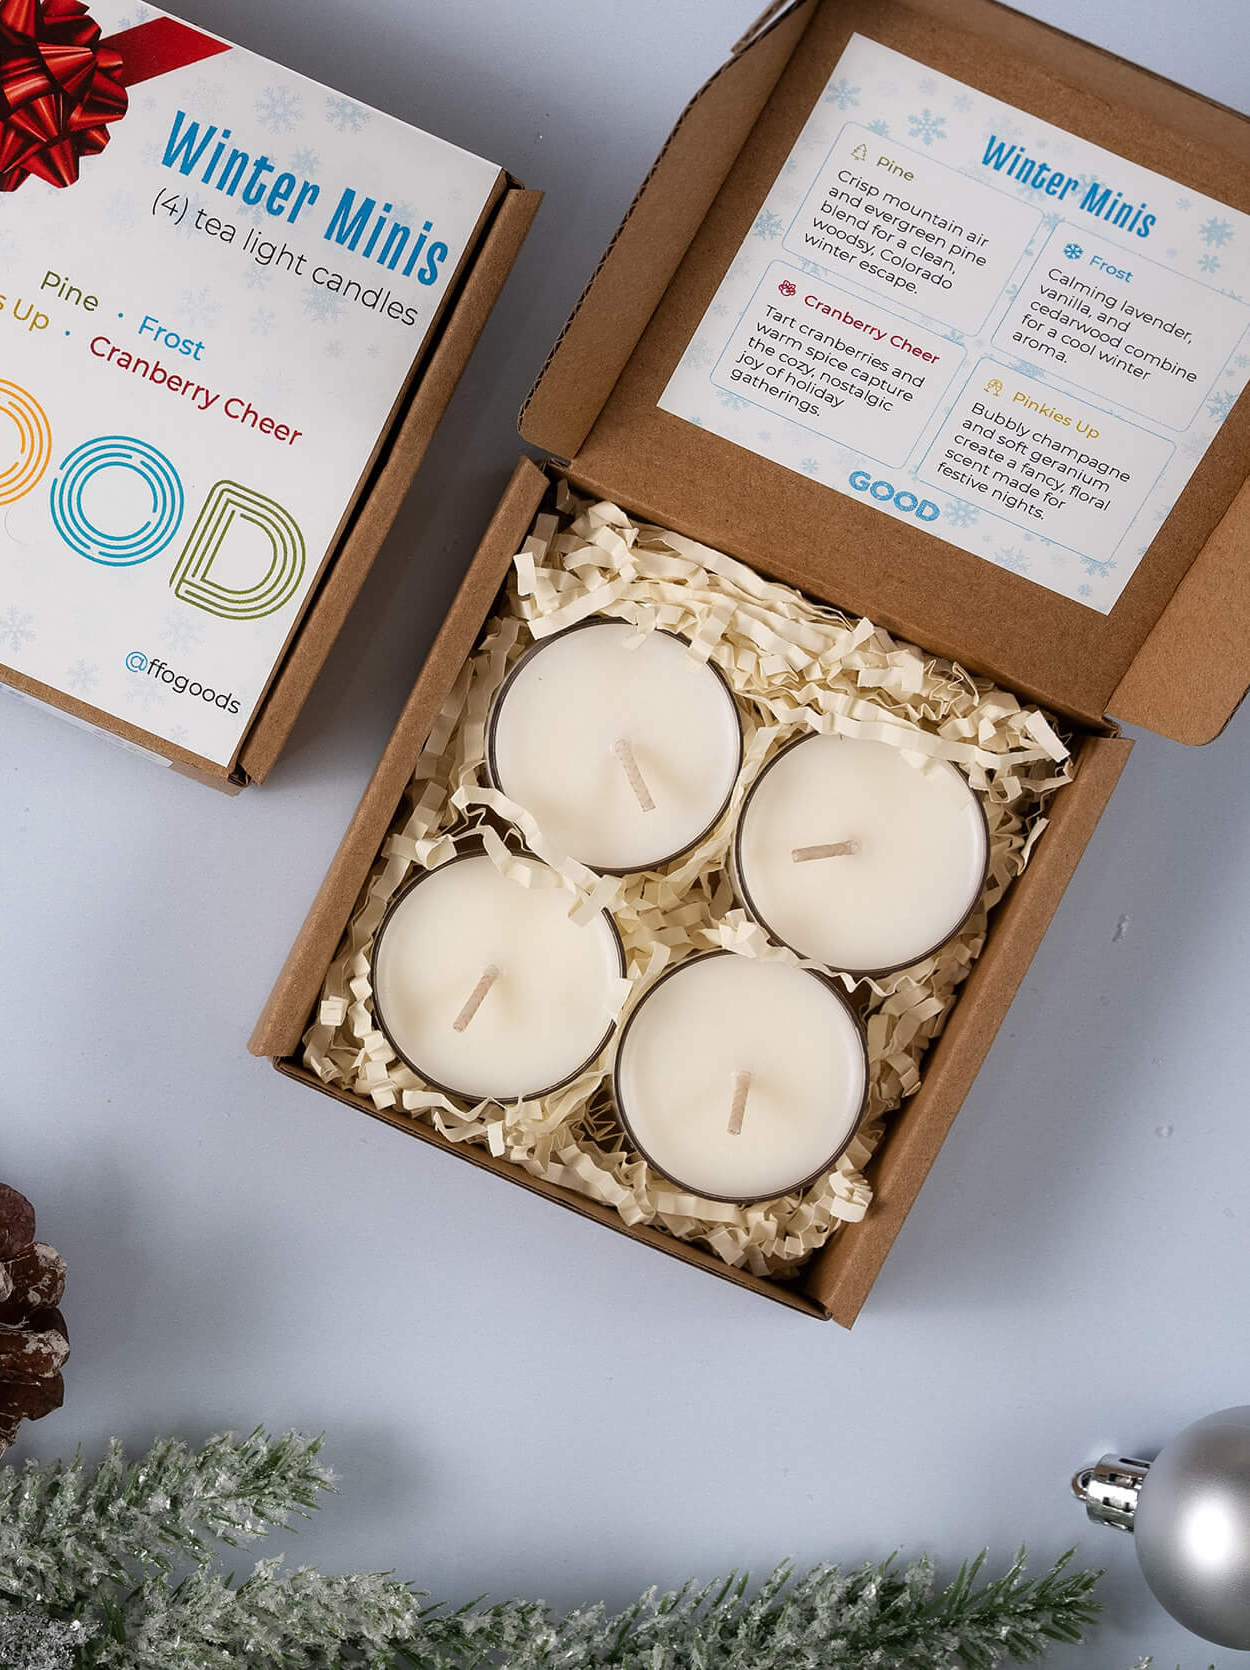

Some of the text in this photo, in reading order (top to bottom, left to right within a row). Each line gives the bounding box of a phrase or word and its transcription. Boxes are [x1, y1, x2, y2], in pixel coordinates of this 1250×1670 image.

[161, 109, 448, 286] Winter Minis
[876, 156, 915, 182] Pine
[981, 135, 1157, 238] Winter Minis
[820, 200, 956, 275] blend for a clean,
[828, 186, 987, 267] and evergreen pine
[838, 170, 990, 248] Crisp mountain air
[152, 187, 419, 326] (4) tea light candles
[805, 233, 918, 294] winter escape.
[813, 217, 953, 290] woodsy, Colorado
[1089, 255, 1134, 284] Frost
[39, 270, 205, 362] Pine Frost
[804, 295, 941, 365] Cranberry Cheer
[1030, 300, 1198, 383] cedarwood combine
[1040, 285, 1132, 333] vanilla, and
[1048, 268, 1193, 345] Calming lavender,
[12, 298, 50, 332] Up
[89, 336, 220, 411] Cranberry
[223, 397, 303, 446] Cheer
[735, 350, 845, 408] joy of holiday
[748, 336, 894, 412] the cozy, nostalgic
[756, 322, 914, 402] warm spice capture
[764, 304, 926, 388] Tart cranberries and
[1012, 331, 1068, 364] aroma.
[1021, 313, 1151, 381] for a cool winter
[730, 368, 820, 416] gatherings.
[1012, 391, 1100, 440] Pinkies Up
[944, 448, 1067, 510] scent made for
[953, 434, 1111, 512] create a fancy, floral
[961, 417, 1111, 493] and soft geranium
[970, 402, 1131, 483] Bubbly champagne
[849, 470, 941, 522] GOOD
[936, 462, 1045, 521] festive nights.
[125, 651, 241, 714] @ffogoods
